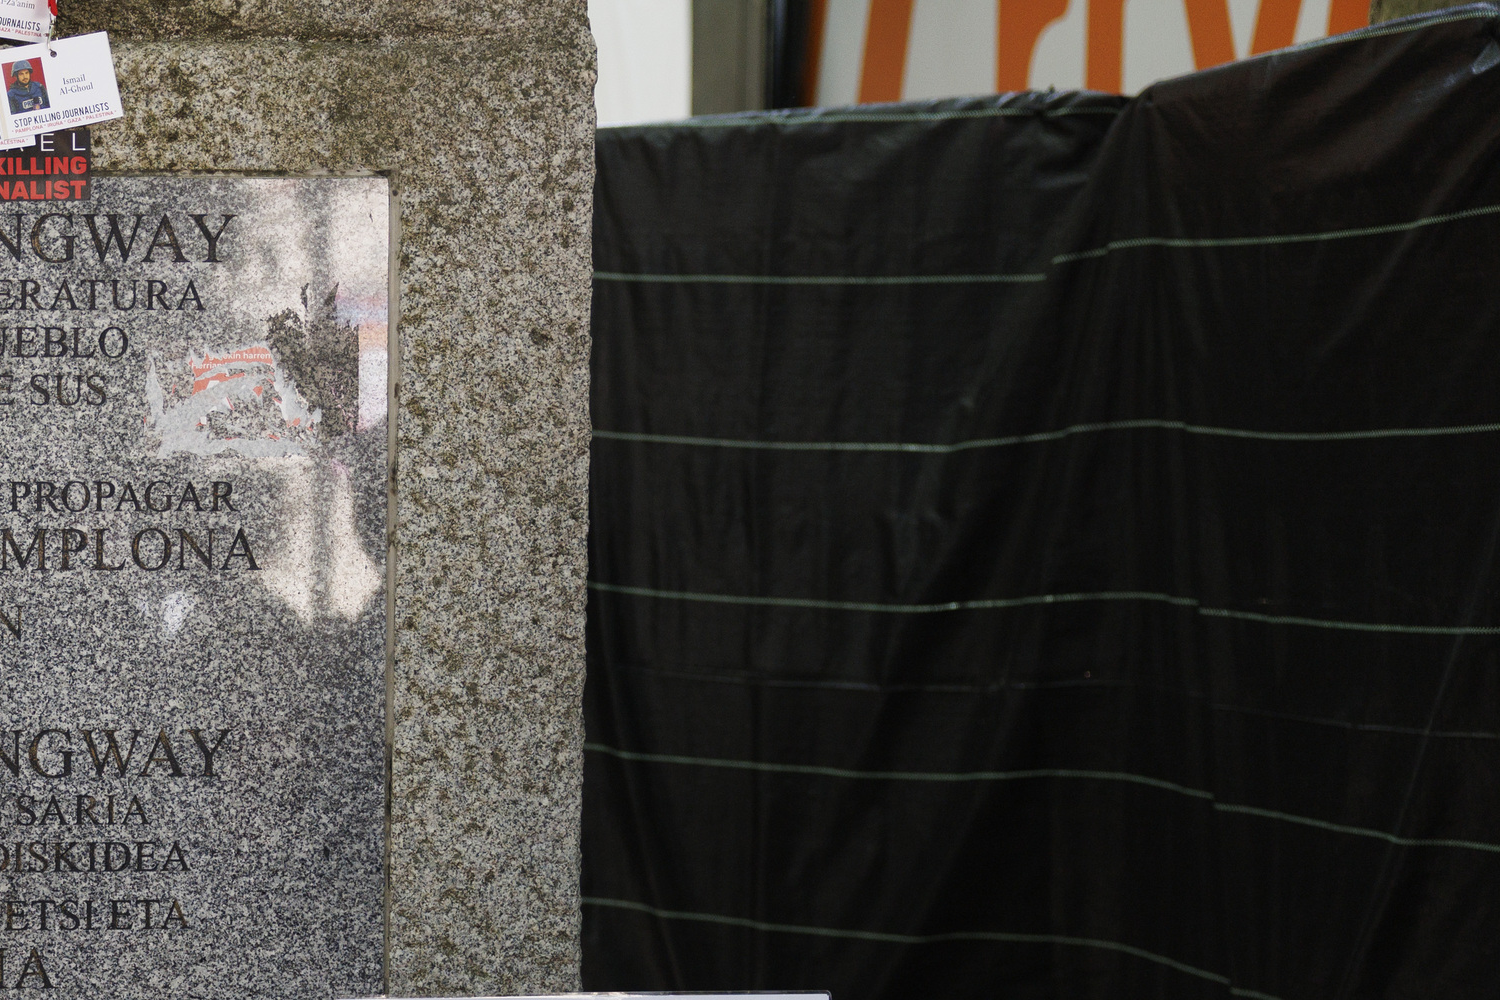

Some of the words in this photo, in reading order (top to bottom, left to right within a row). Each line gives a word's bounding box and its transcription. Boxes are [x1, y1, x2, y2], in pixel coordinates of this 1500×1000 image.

[59, 83, 93, 95] Al-Ghoul
[63, 74, 86, 85] Ismail
[14, 118, 31, 128] STOP
[34, 112, 61, 125] KILLING
[62, 102, 109, 119] JOURNALISTS
[30, 374, 107, 406] SUS
[10, 480, 240, 512] PROPAGAR
[16, 795, 149, 826] SARIA
